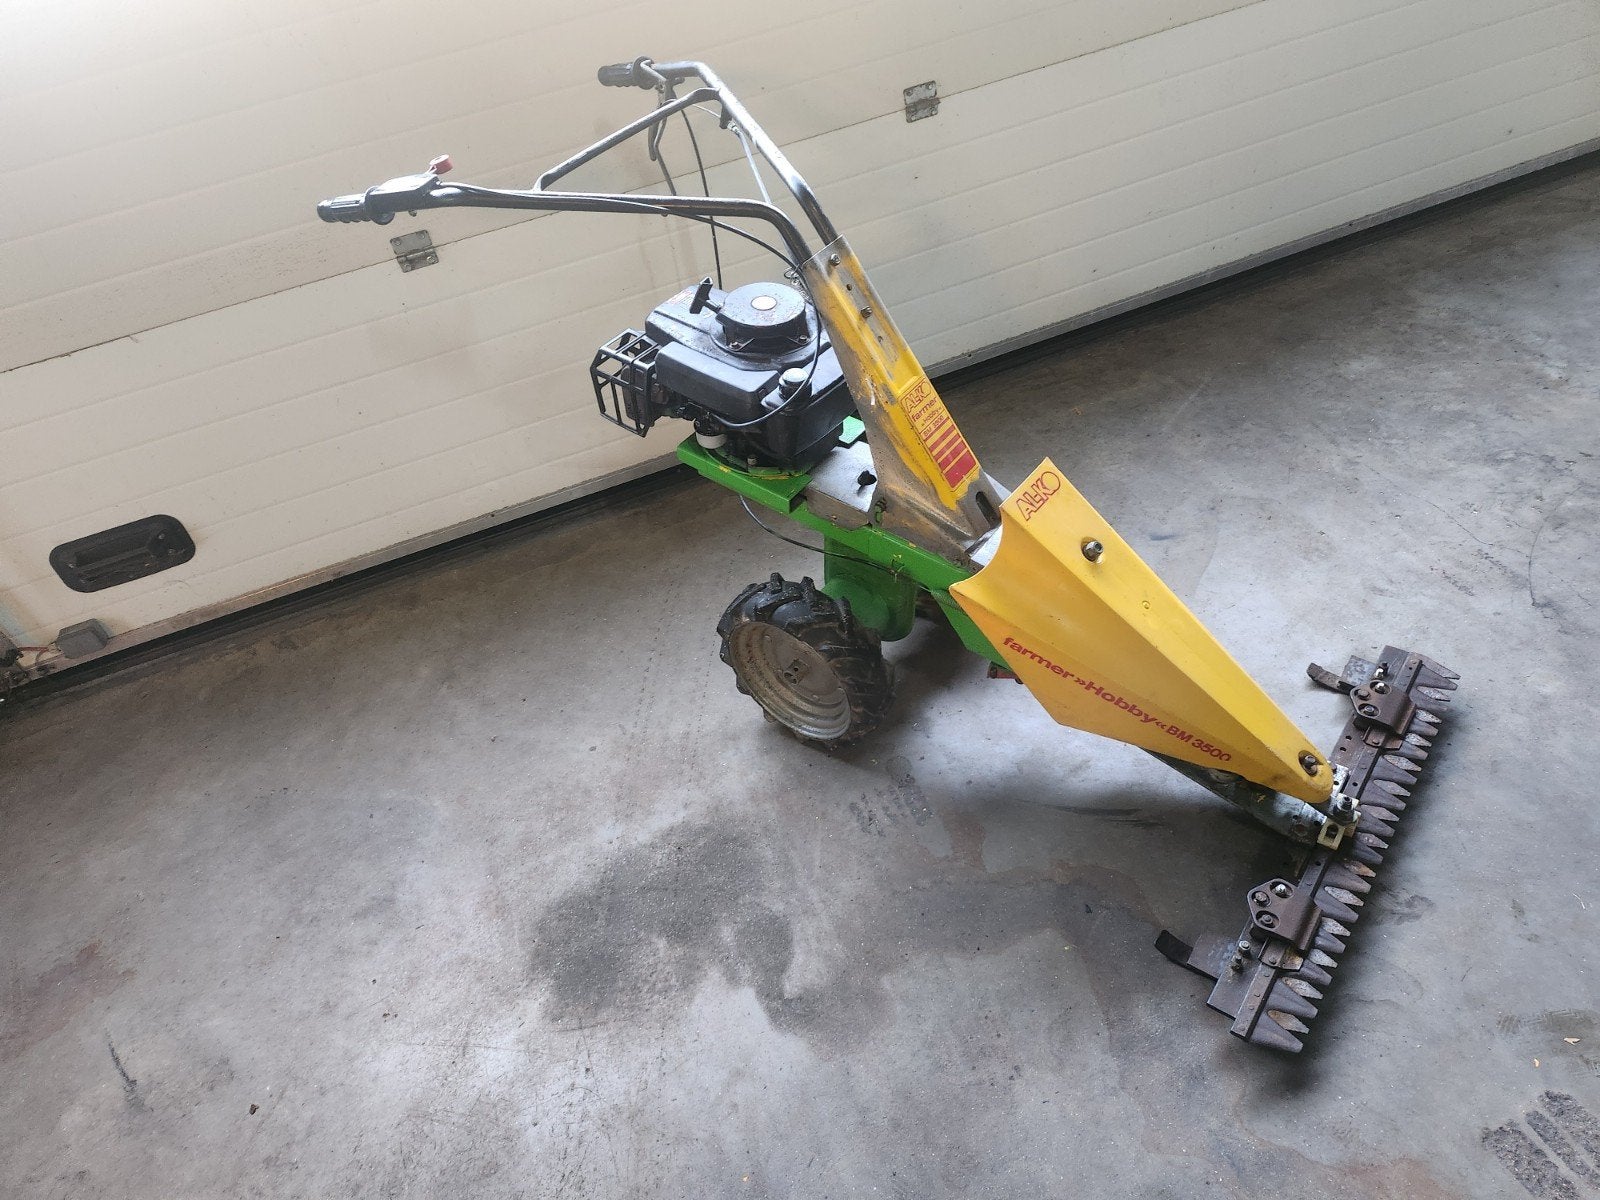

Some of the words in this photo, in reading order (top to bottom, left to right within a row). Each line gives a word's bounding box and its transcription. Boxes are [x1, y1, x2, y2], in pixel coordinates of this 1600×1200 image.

[911, 397, 938, 422] farmer
[1002, 637, 1074, 679] farmer
[1165, 724, 1195, 743] BM
[1191, 739, 1232, 762] 3500
